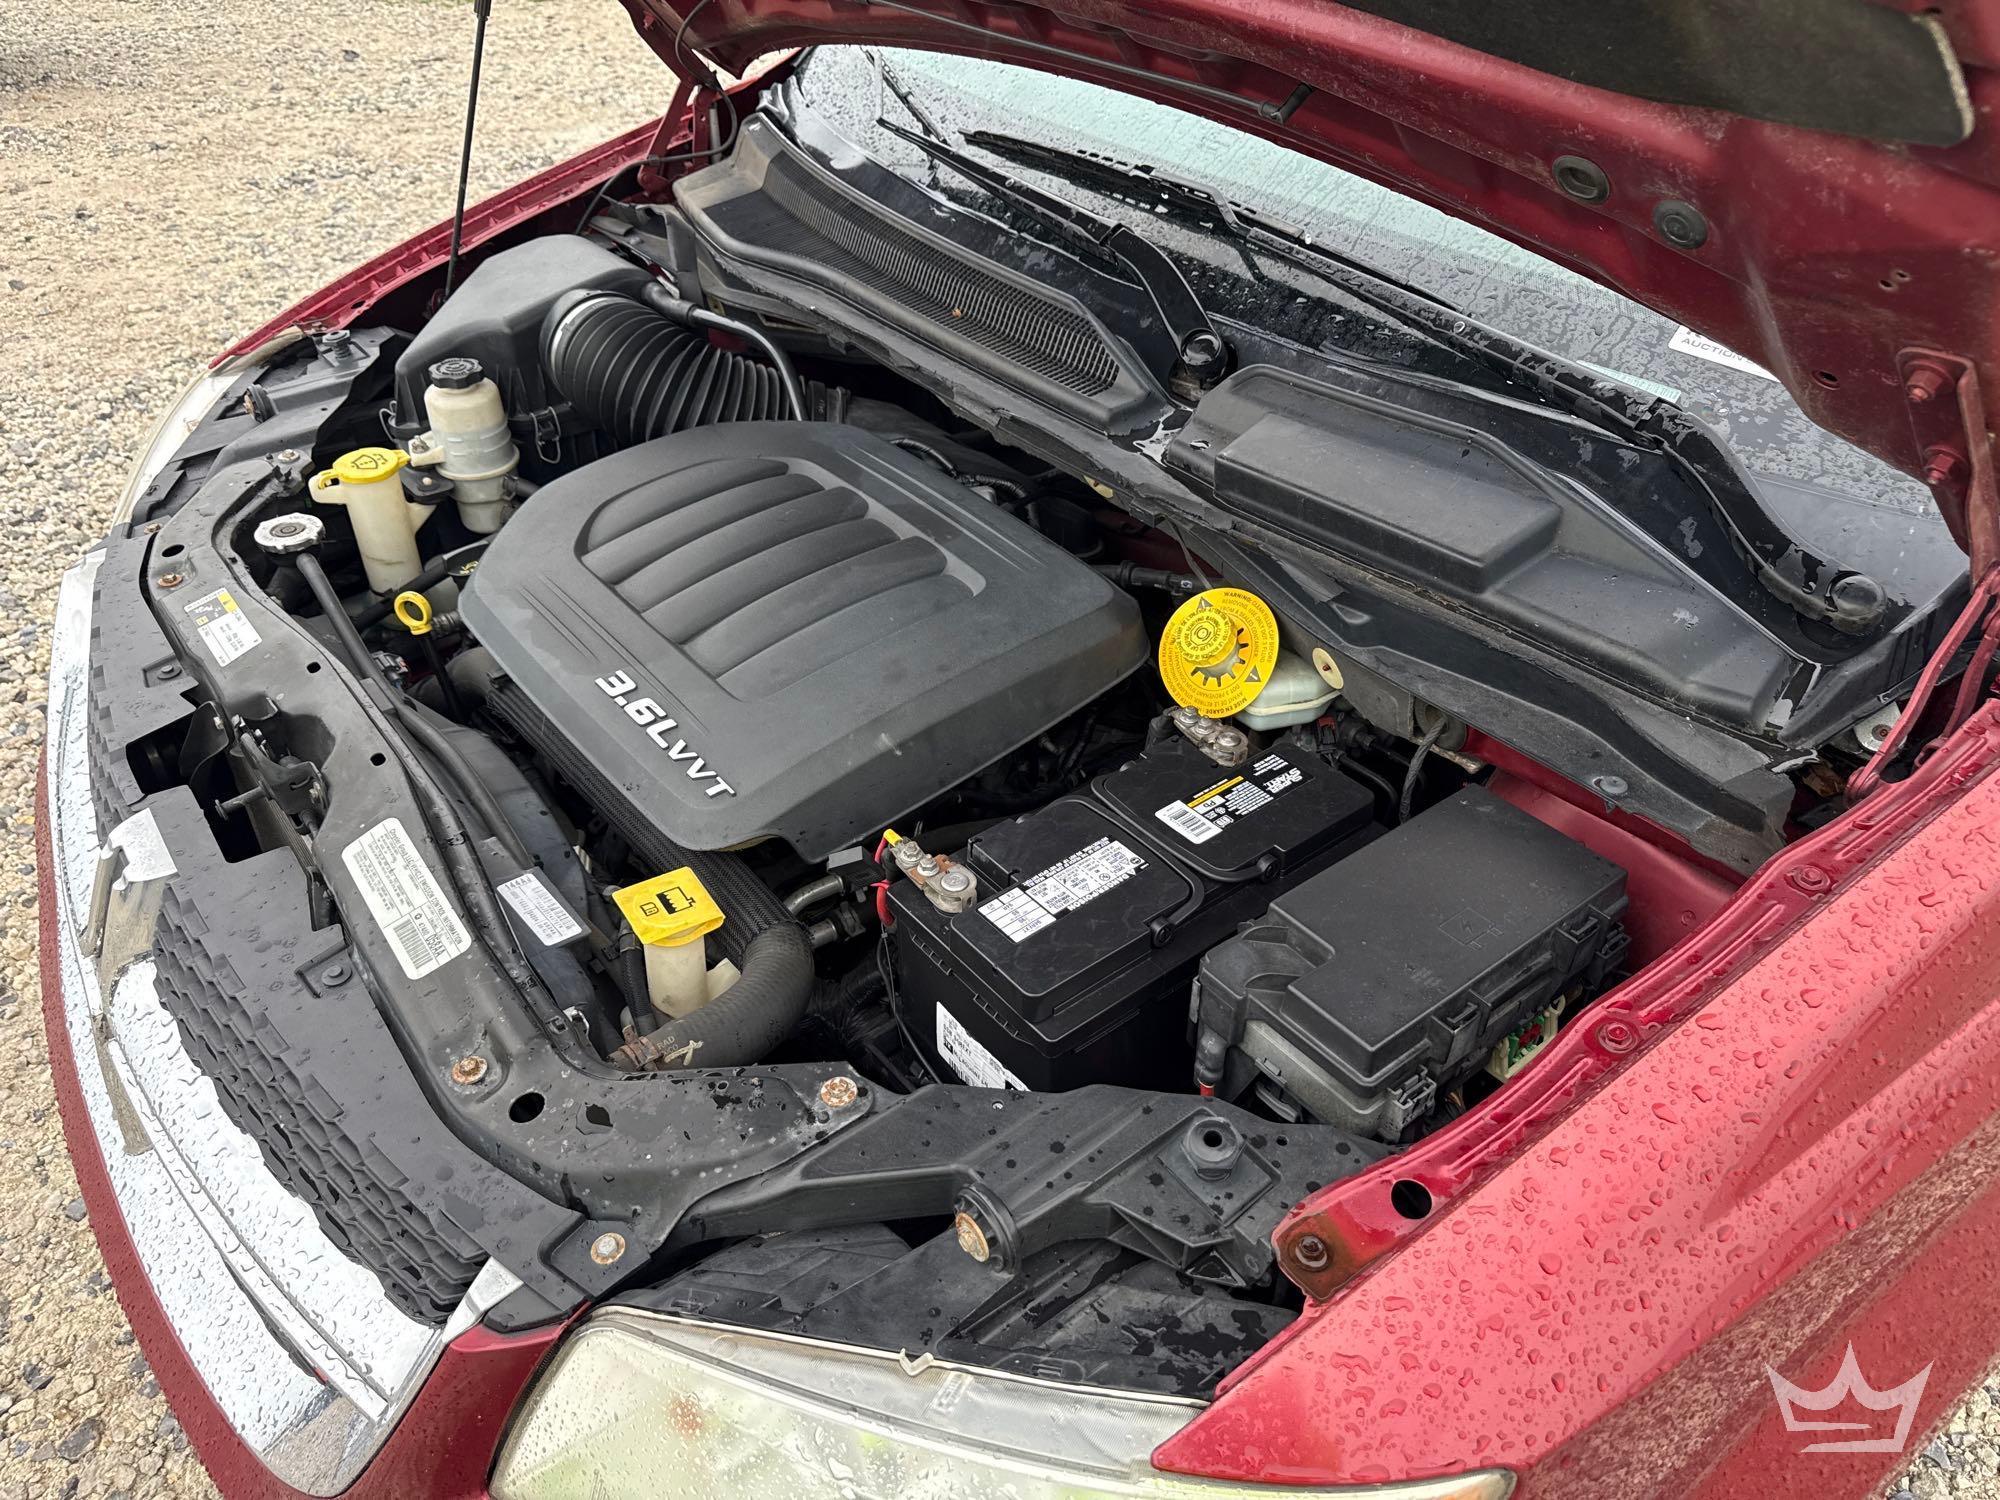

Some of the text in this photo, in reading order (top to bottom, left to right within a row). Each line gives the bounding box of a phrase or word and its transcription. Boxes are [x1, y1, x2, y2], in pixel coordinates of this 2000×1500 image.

[1266, 775, 1303, 794] SUPER
[1202, 799, 1216, 809] Pb
[430, 896, 446, 916] CONTROL
[441, 915, 463, 945] INFORMATION
[656, 1035, 676, 1050] RAD
